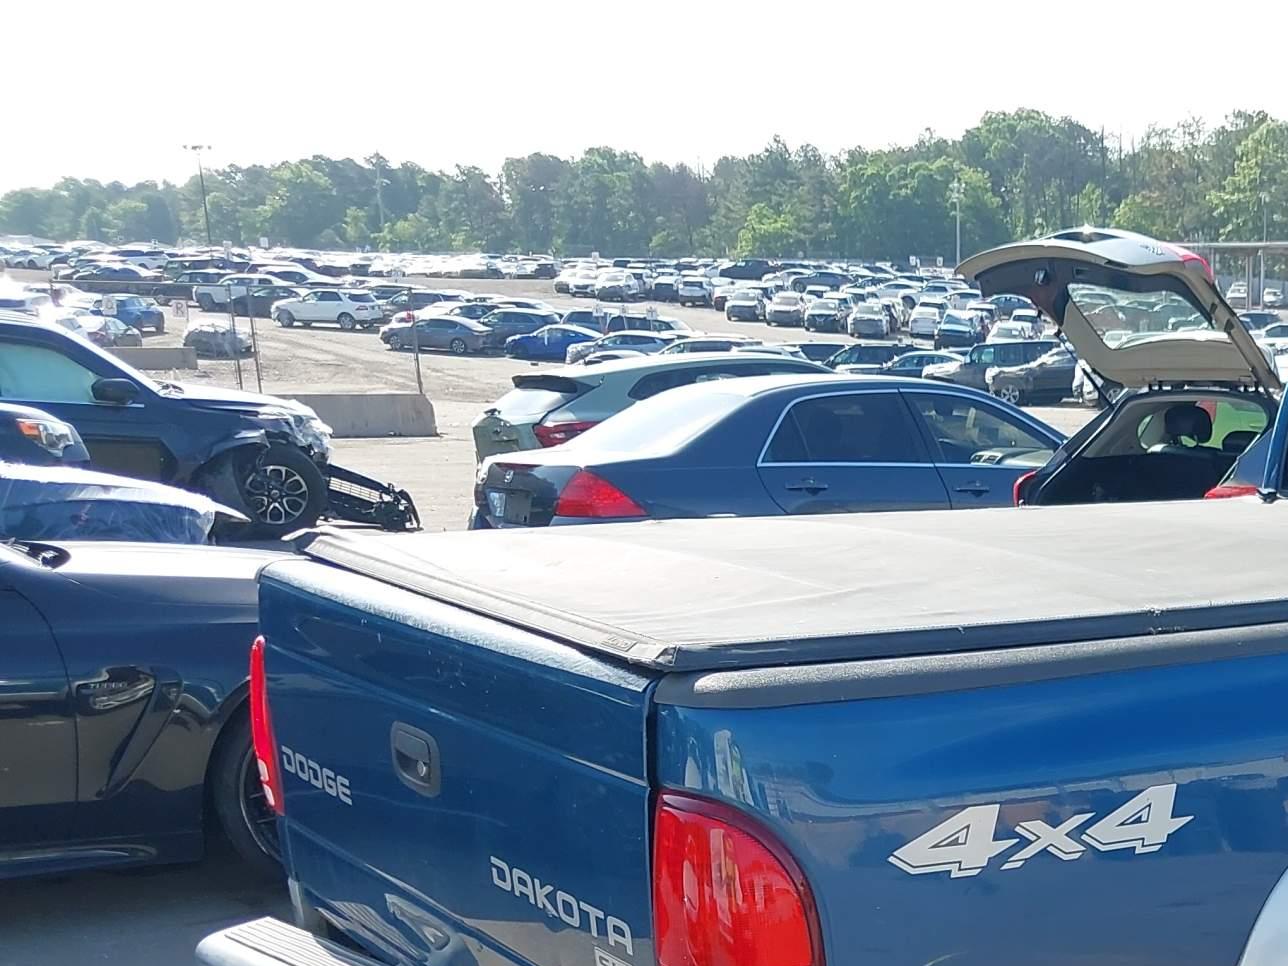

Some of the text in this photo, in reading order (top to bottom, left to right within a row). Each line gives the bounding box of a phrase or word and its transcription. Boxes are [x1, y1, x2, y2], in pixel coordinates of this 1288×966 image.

[175, 301, 185, 315] R
[281, 745, 353, 806] DODGE
[887, 783, 1194, 878] 4x4
[490, 855, 634, 957] DAKOTA
